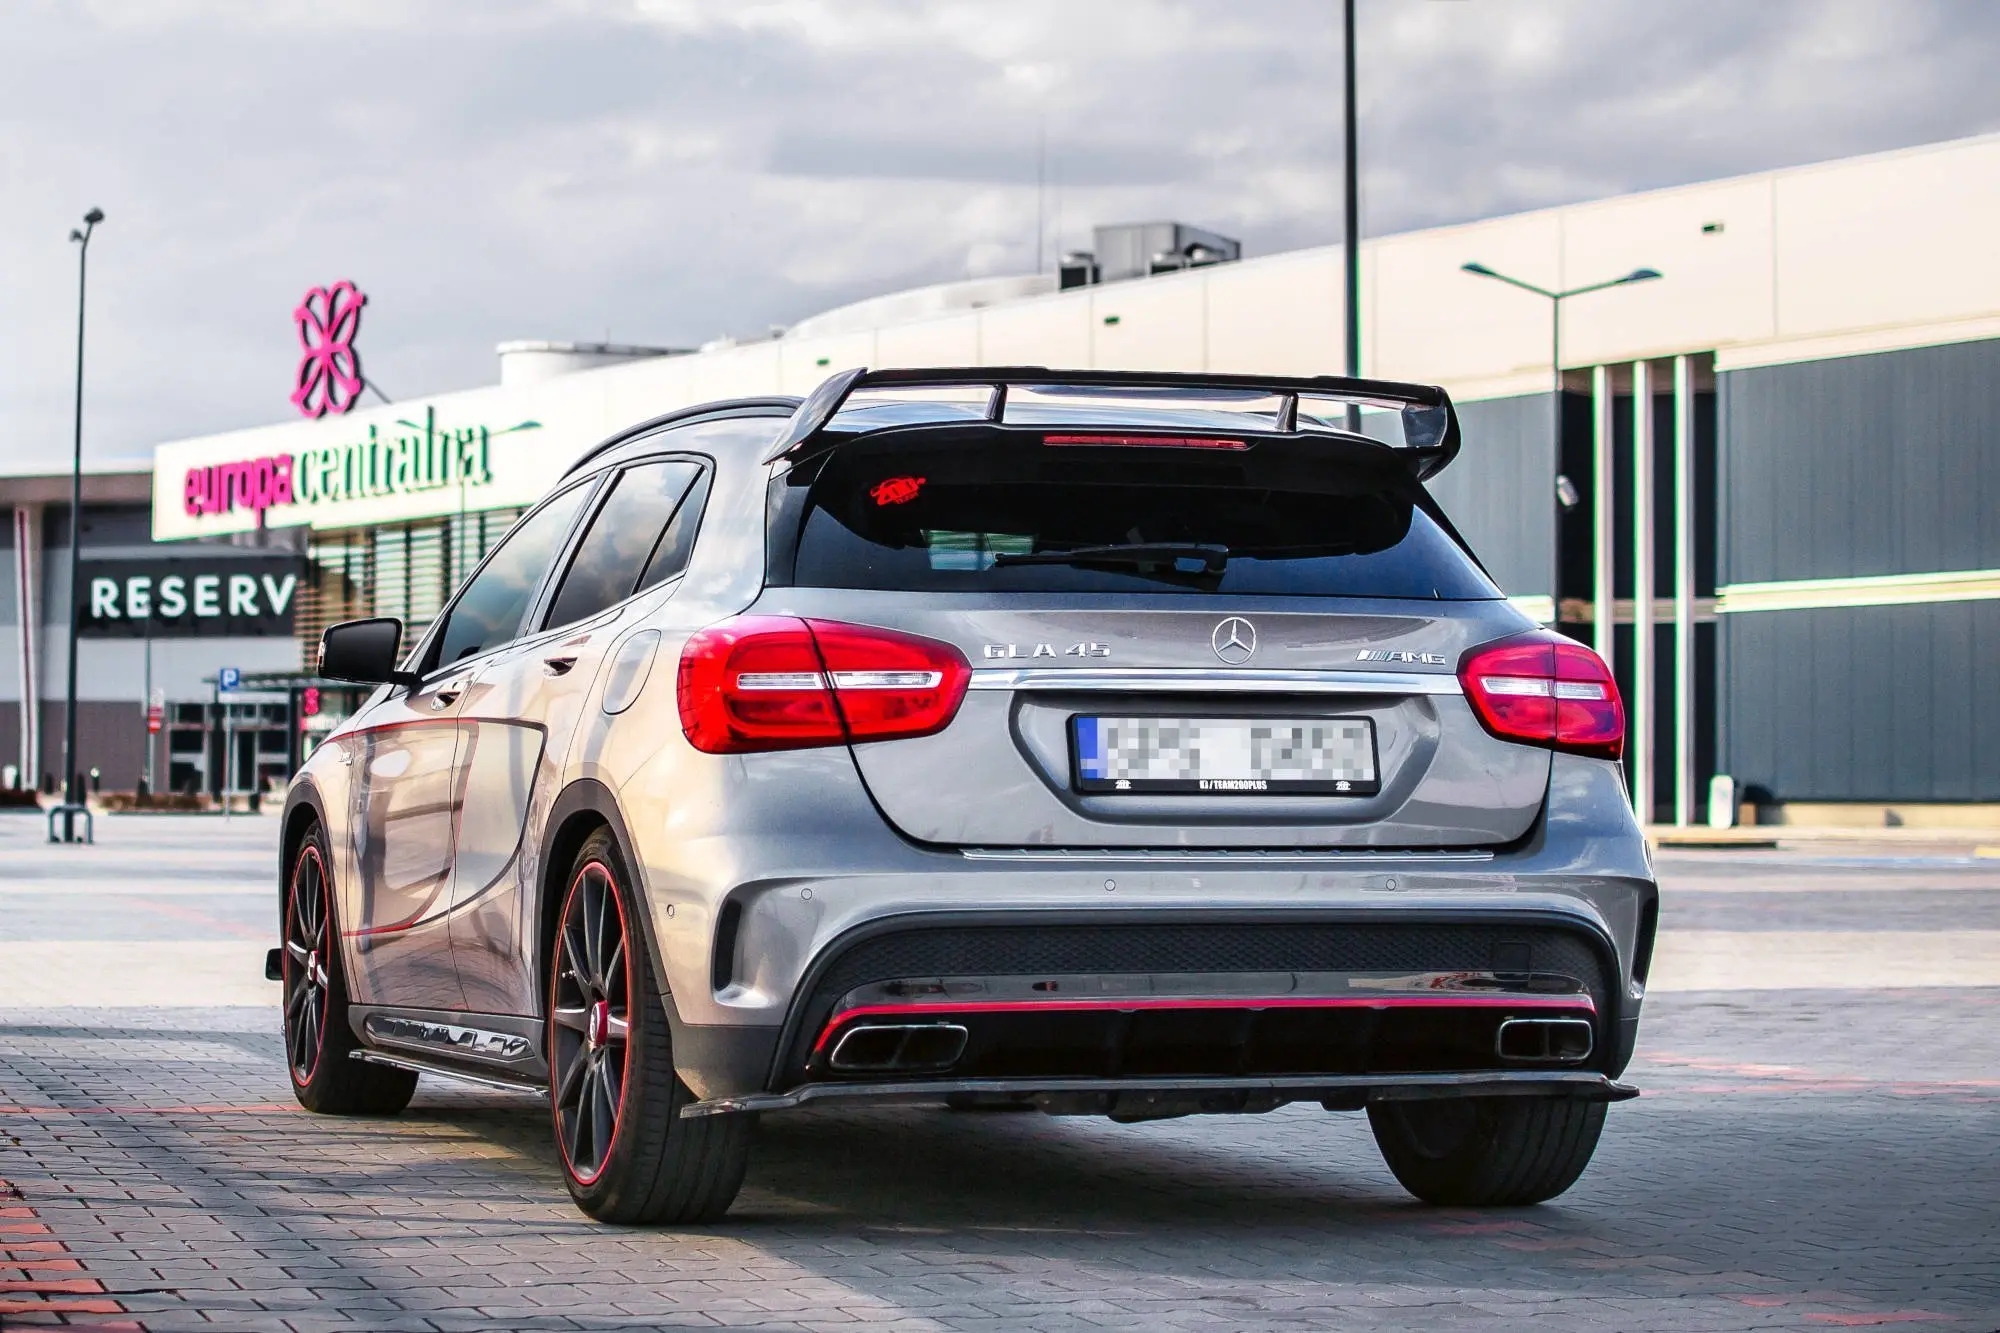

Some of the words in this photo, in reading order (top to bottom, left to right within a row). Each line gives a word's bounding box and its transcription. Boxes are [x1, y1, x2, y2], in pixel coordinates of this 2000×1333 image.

[184, 454, 294, 529] europa
[91, 573, 297, 618] RESERV
[983, 643, 1057, 659] GLA
[1065, 642, 1111, 657] 45
